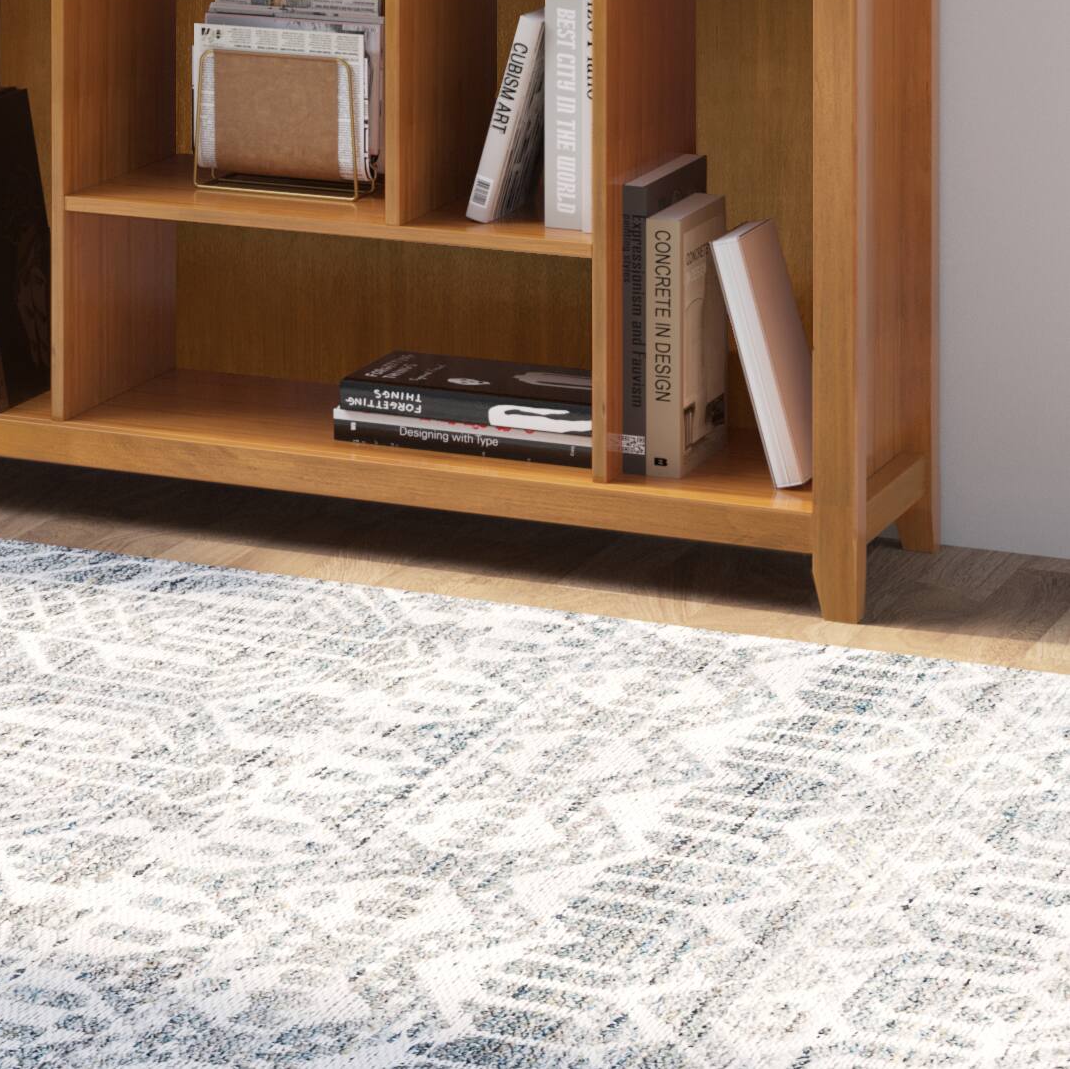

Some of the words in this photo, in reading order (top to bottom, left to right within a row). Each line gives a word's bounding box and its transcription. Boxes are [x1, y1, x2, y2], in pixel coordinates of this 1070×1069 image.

[556, 8, 576, 50] BEST
[502, 42, 529, 101] CUBISM
[556, 53, 576, 92] CITY
[491, 101, 510, 135] ART
[556, 119, 576, 152] THE
[556, 154, 576, 215] WORLD
[632, 214, 646, 316] Expressionism
[654, 230, 672, 318] CONCRETE
[632, 321, 646, 346] and
[654, 322, 672, 338] IN
[632, 350, 646, 408] Fauvism
[654, 342, 672, 402] DESIGN
[346, 396, 422, 414] FORGETTING
[373, 389, 422, 403] THINGS
[400, 426, 450, 444] Designing
[451, 432, 474, 444] with
[474, 435, 499, 447] Type
